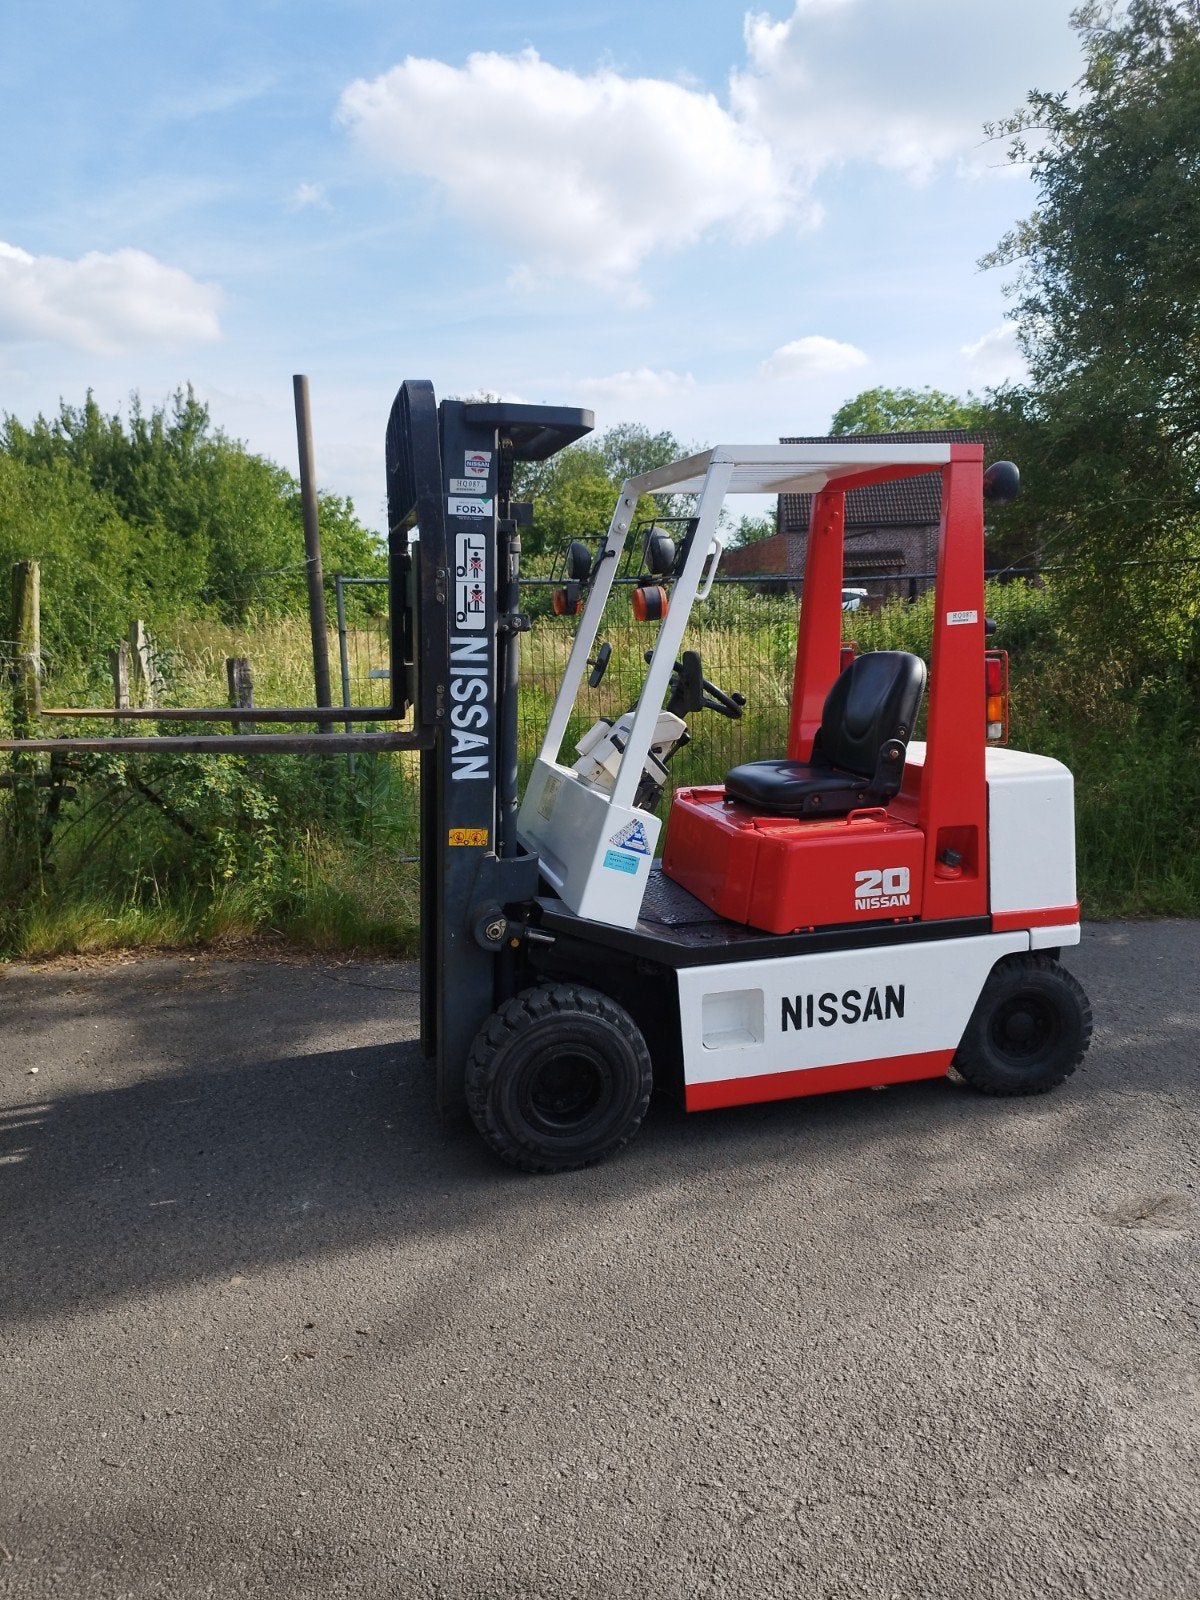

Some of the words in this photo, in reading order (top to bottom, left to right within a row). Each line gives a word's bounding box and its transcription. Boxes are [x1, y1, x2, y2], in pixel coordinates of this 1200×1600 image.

[456, 505, 485, 514] FORX
[449, 636, 489, 780] NISSAN
[855, 866, 910, 898] 20
[855, 894, 910, 911] NISSAN
[782, 984, 905, 1032] NISSAN
